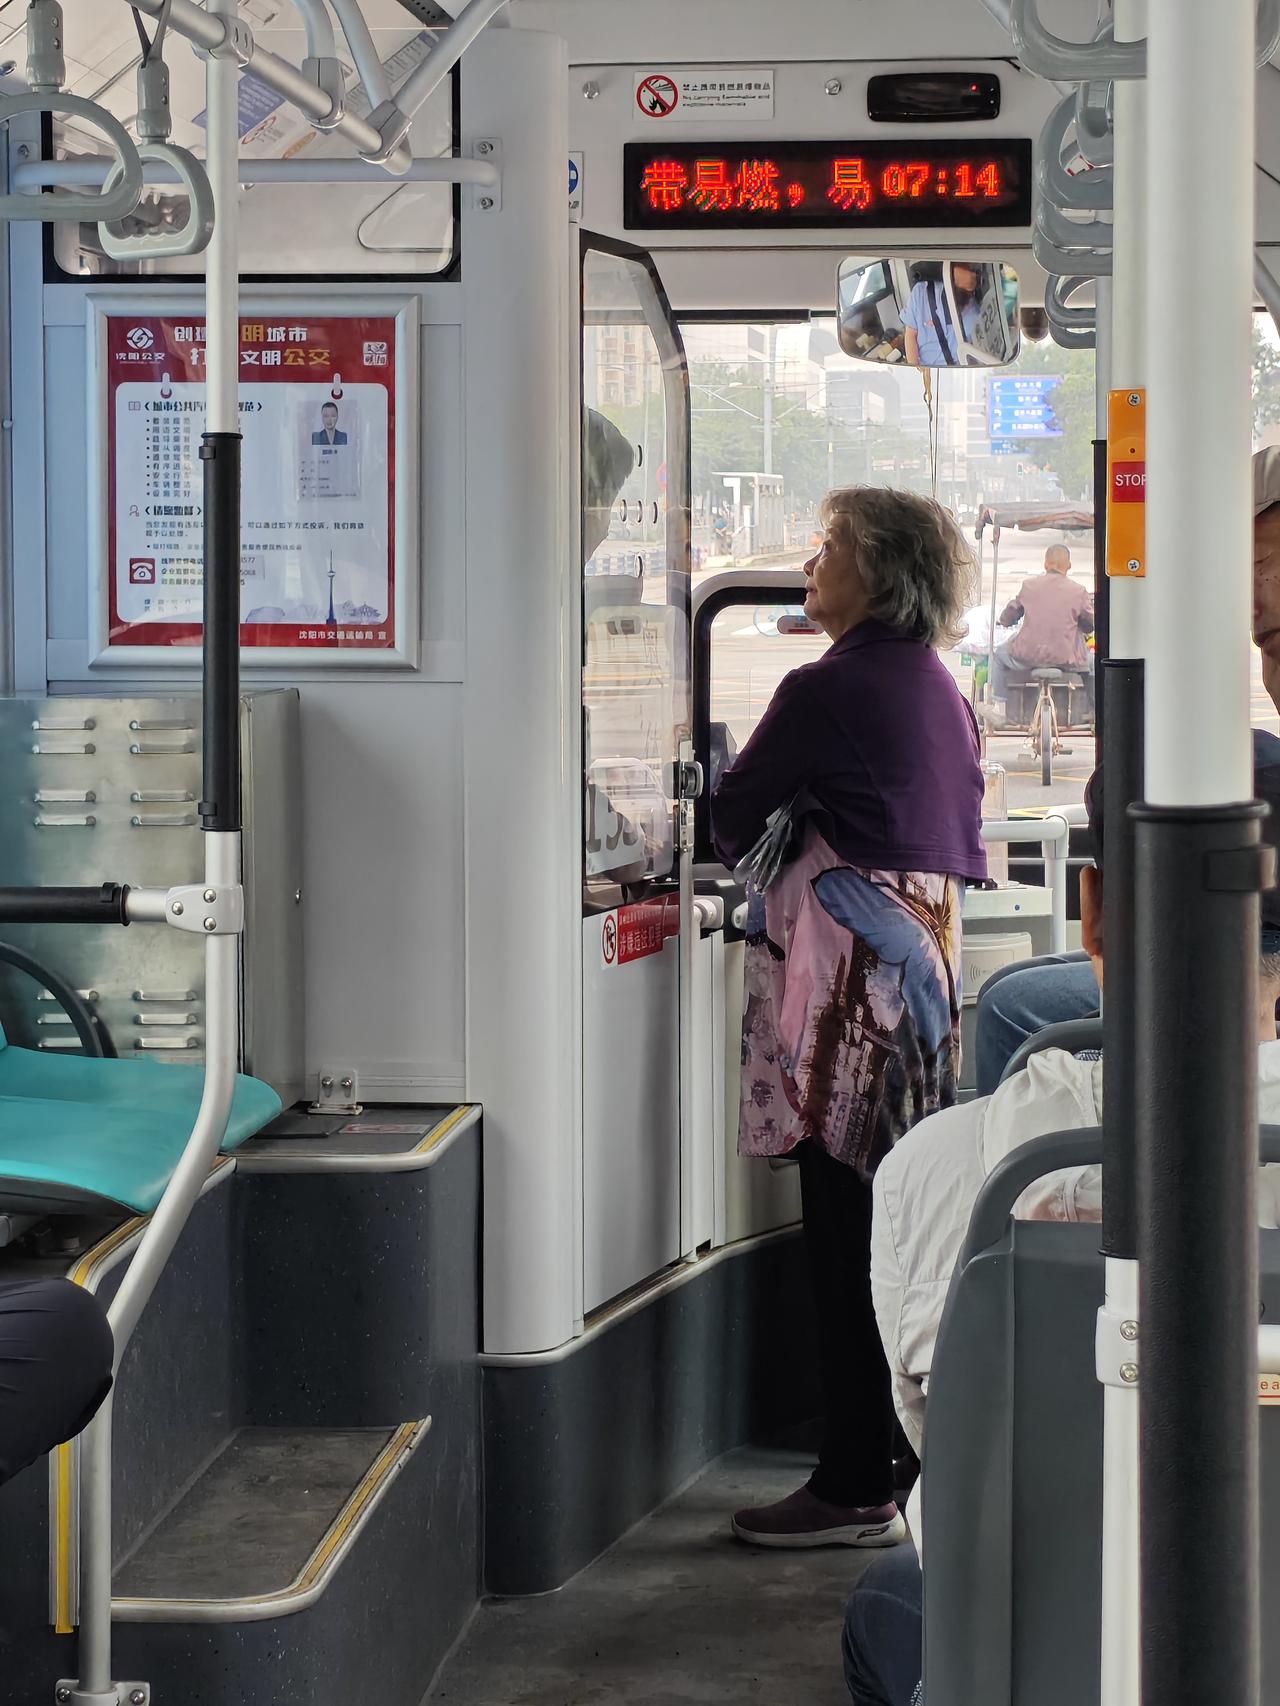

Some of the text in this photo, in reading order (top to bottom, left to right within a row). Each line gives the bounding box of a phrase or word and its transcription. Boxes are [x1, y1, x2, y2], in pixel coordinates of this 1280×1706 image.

[883, 164, 998, 197] 07:14
[174, 325, 307, 342] 创建明城市
[191, 348, 330, 365] 打文明公交
